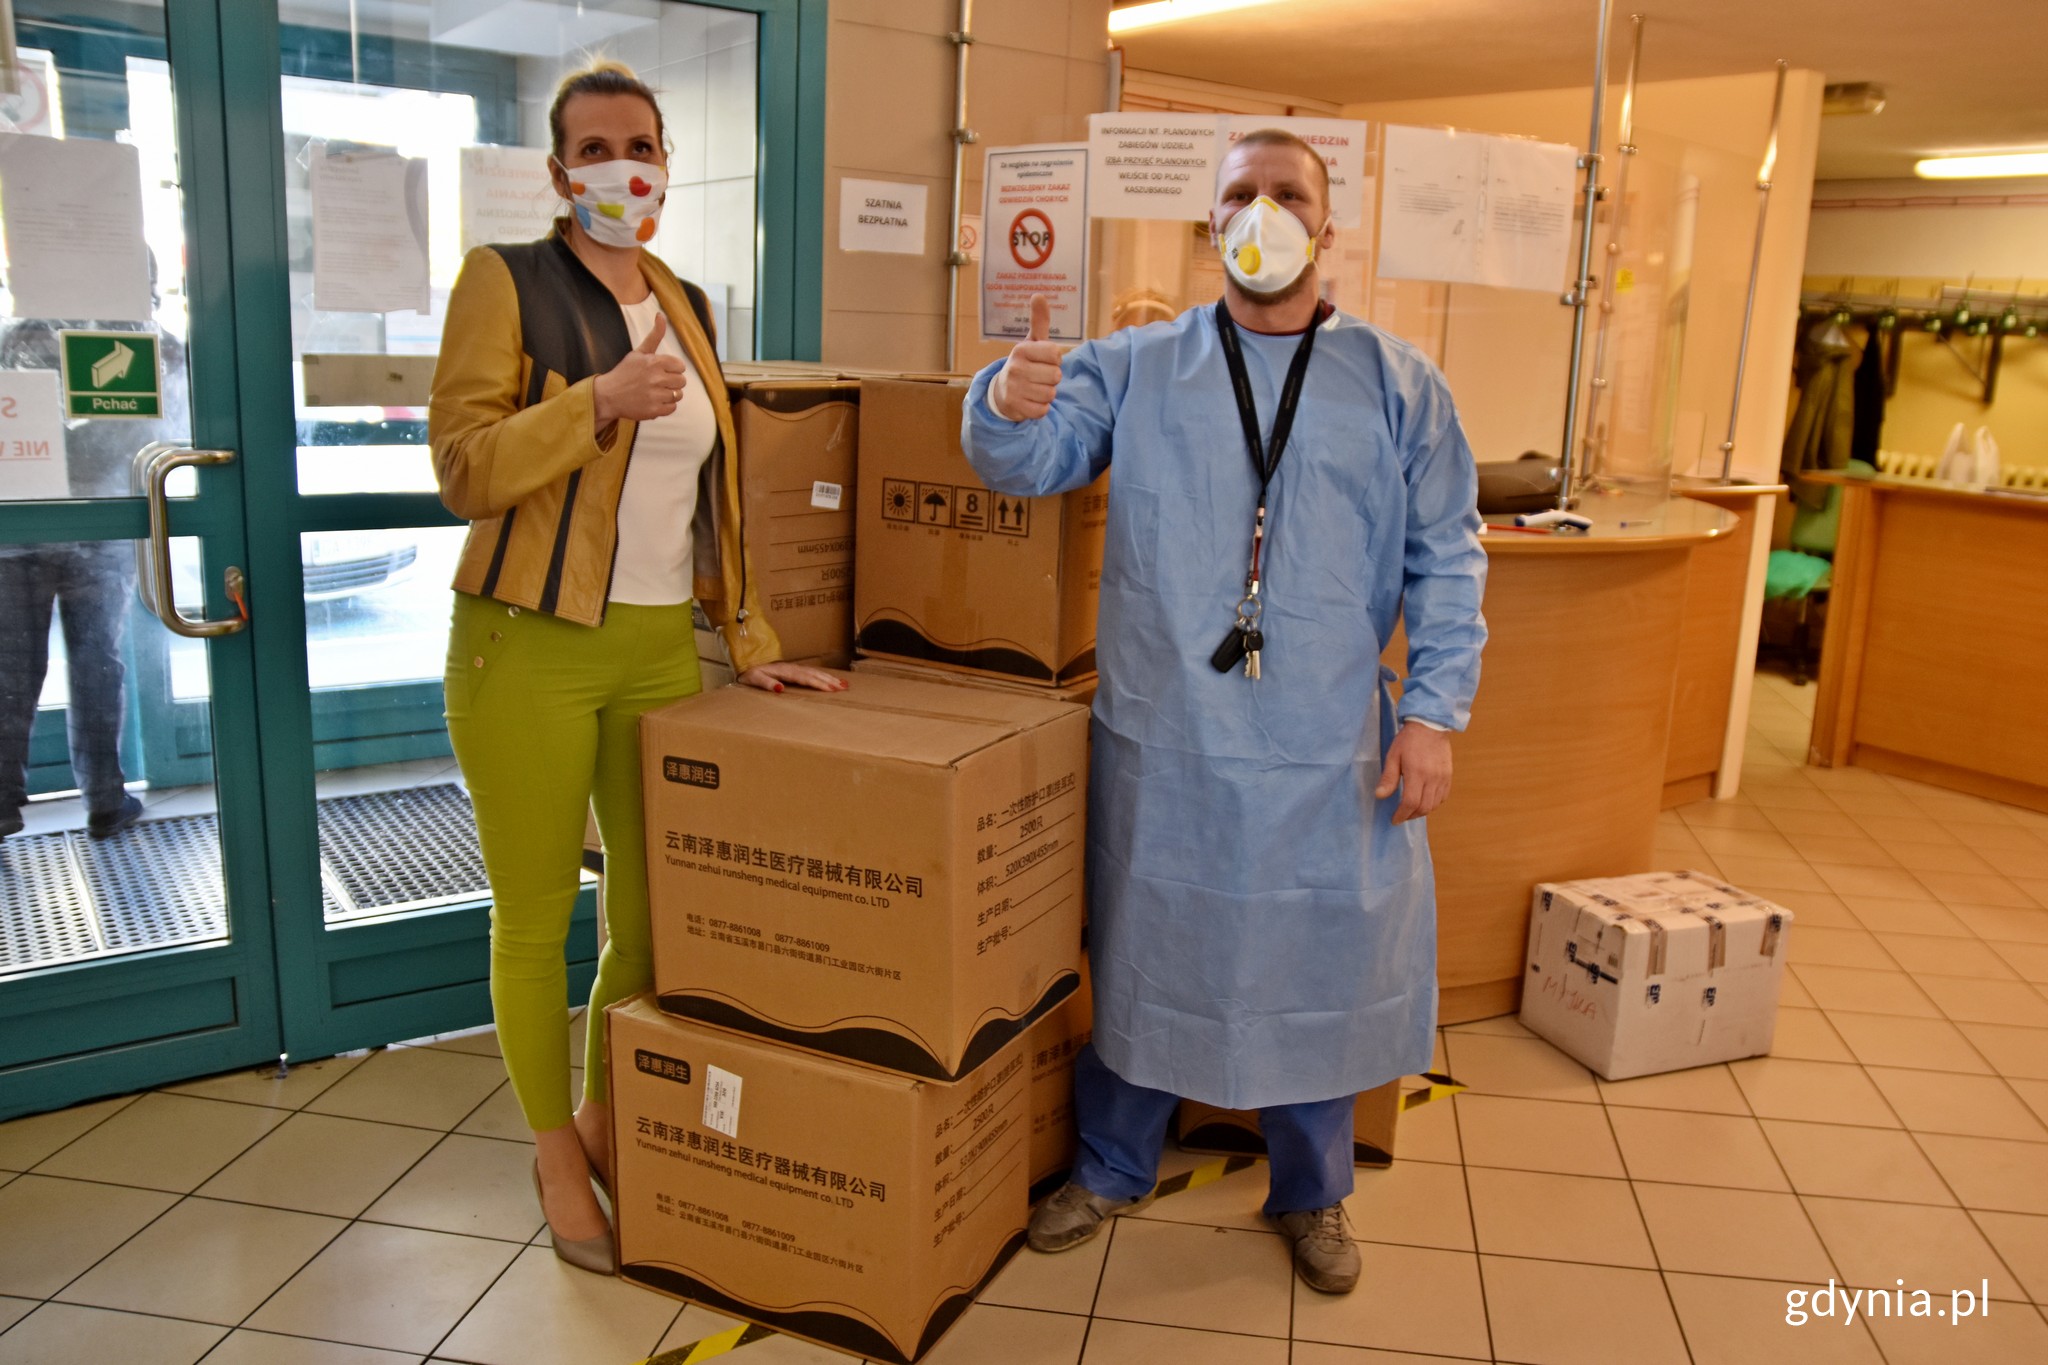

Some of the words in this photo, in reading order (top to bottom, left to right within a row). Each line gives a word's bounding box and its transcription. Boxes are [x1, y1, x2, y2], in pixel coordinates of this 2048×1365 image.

[1163, 128, 1216, 136] PLANOWYCH
[1118, 140, 1159, 149] ZABIEGÓW
[1161, 141, 1195, 150] UDZIELA
[1105, 156, 1122, 164] IZBA
[1155, 158, 1208, 166] PLANOWYCH
[1119, 171, 1150, 180] WEJŚCIE
[1151, 172, 1163, 180] OD
[1164, 173, 1191, 181] PLACU
[1124, 186, 1183, 194] KASZUBSKIEGO
[865, 198, 902, 209] SZATNIA
[858, 215, 908, 227] BEZPŁATNA
[1013, 230, 1050, 246] STOP
[92, 397, 138, 410] Pchać
[966, 493, 978, 513] 8
[665, 760, 718, 786] 泽惠润生
[665, 830, 923, 898] 云南泽惠润生医疗器械有限公司
[665, 854, 697, 870] Yunnan
[698, 863, 721, 876] zehui
[723, 868, 764, 886] runsheng
[766, 877, 800, 892] medical
[802, 883, 853, 902] equipment
[855, 894, 869, 905] co.
[871, 895, 890, 909] LTD
[708, 918, 762, 938] 0877-8861008
[774, 933, 830, 953] 0877-8861009
[638, 1053, 689, 1082] 泽惠润生
[636, 1115, 886, 1203] 云南泽惠润生医疗器械有限公司
[636, 1138, 664, 1156] Yunnan
[668, 1149, 691, 1163] zehui
[693, 1156, 732, 1177] runsheng
[734, 1168, 768, 1186] medical
[769, 1178, 819, 1200] equipment
[820, 1192, 834, 1204] co.
[836, 1196, 854, 1209] LTD
[678, 1199, 729, 1223] 0877-8861008
[741, 1220, 796, 1243] 0877-8861009
